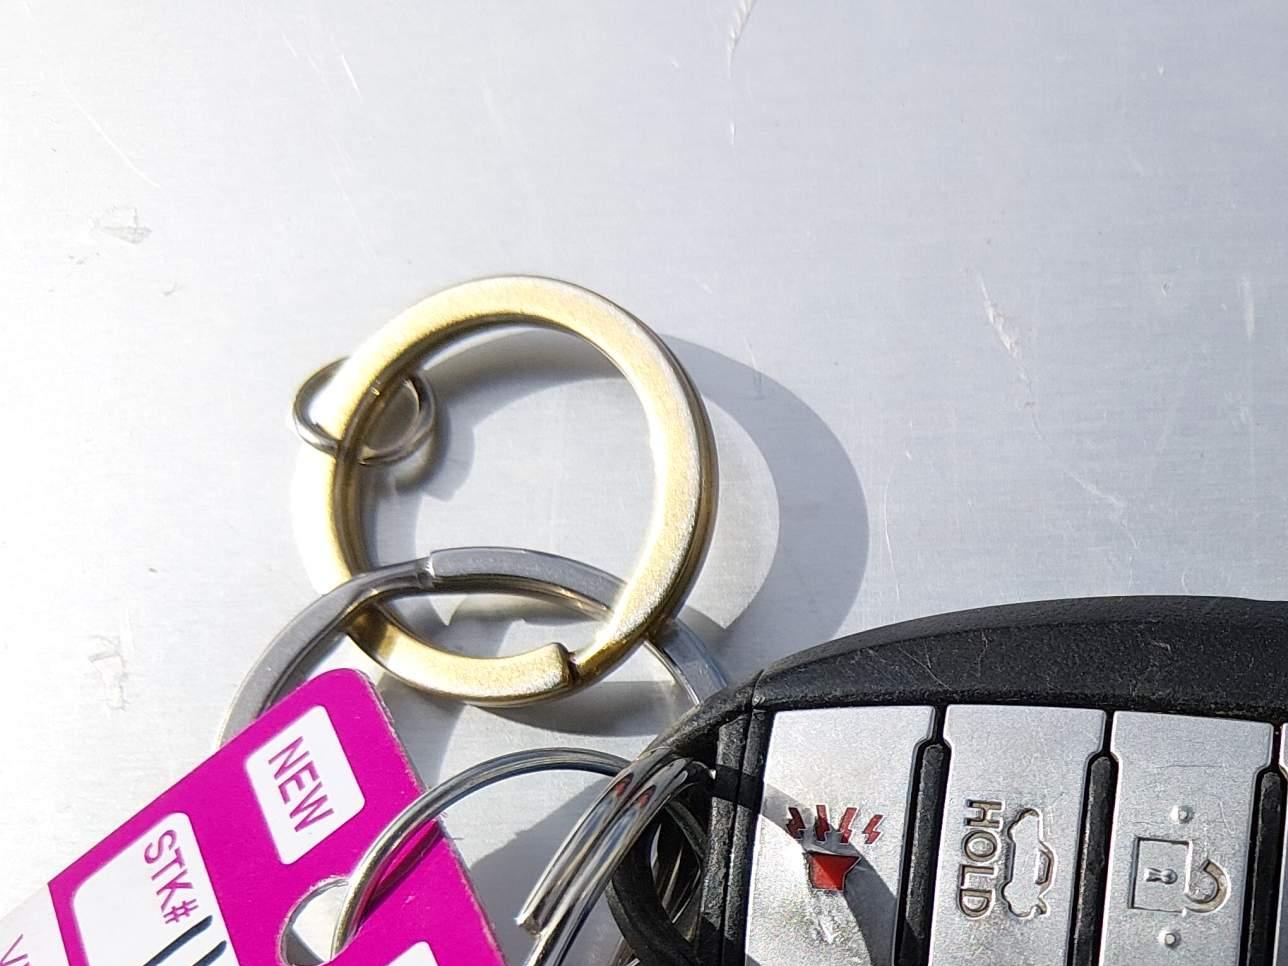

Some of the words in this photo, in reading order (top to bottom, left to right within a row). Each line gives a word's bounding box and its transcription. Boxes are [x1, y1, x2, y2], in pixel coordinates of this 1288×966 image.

[267, 735, 335, 833] NEW
[143, 828, 200, 924] STK#
[958, 798, 1004, 918] HOLD
